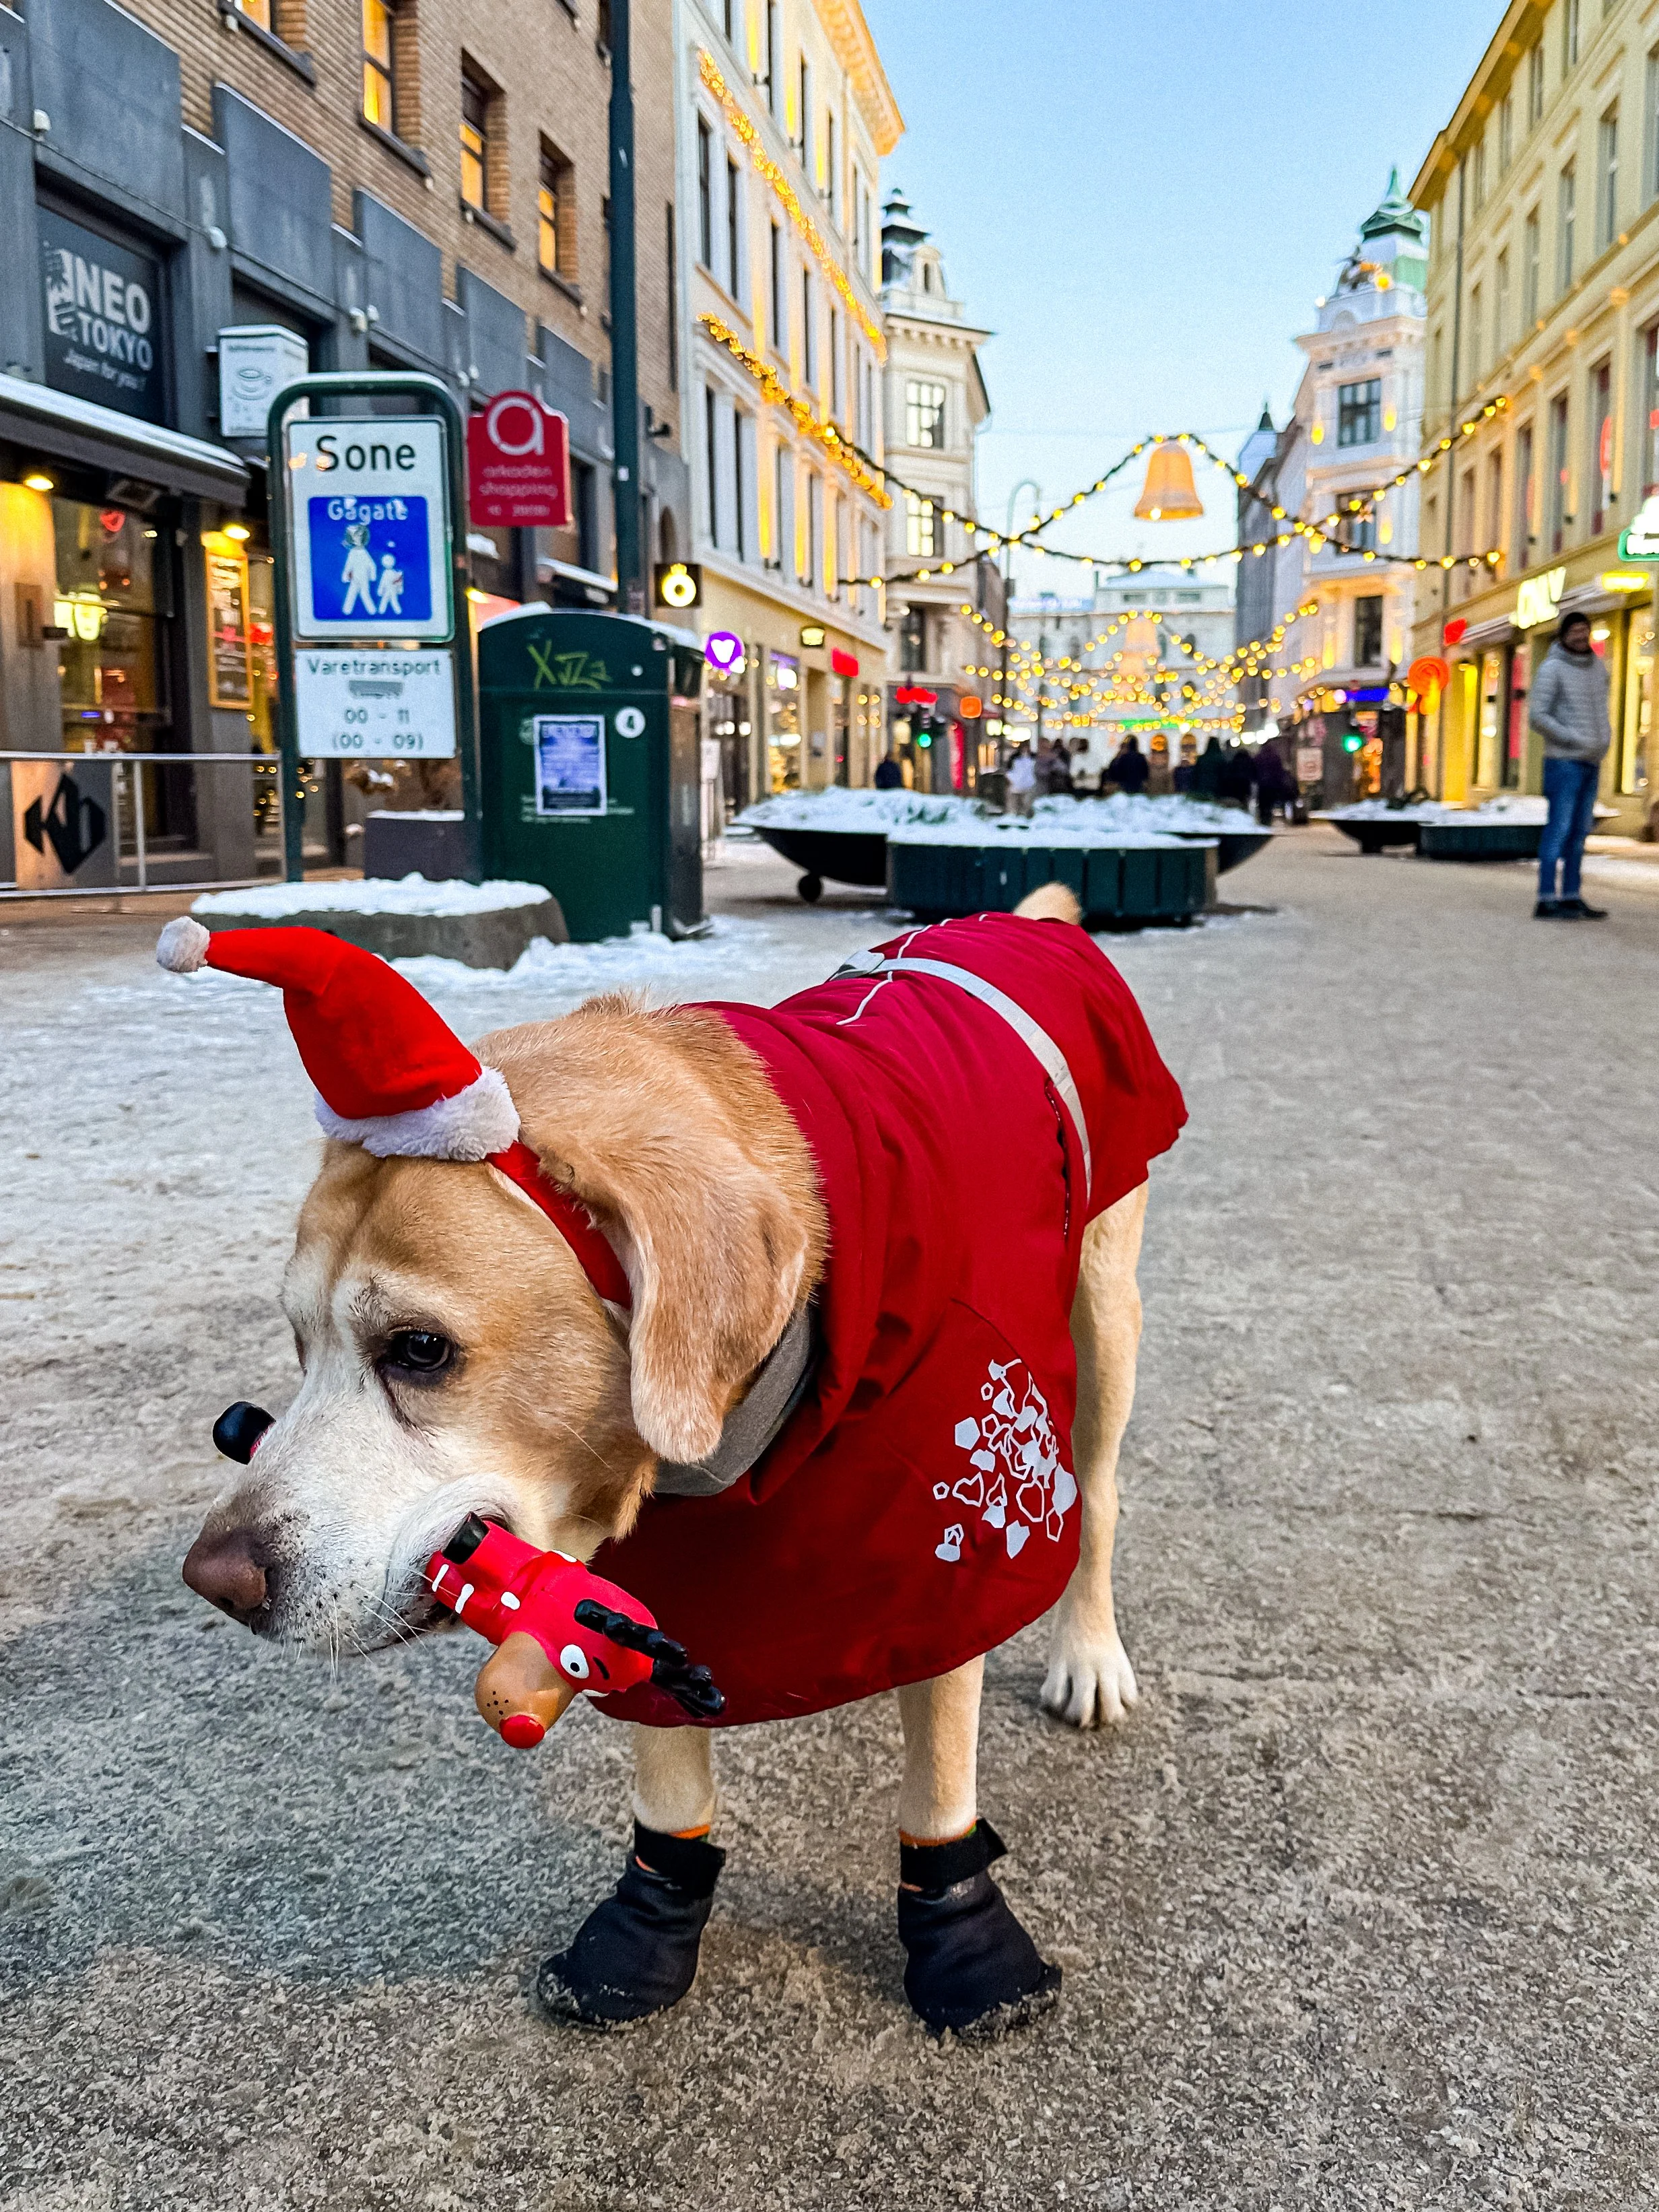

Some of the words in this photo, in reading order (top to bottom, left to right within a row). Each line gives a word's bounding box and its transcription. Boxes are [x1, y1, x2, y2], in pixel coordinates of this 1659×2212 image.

[75, 255, 151, 335] NEO
[77, 312, 154, 371] TOKYO
[316, 435, 416, 471] Sone
[308, 658, 441, 675] Varetransport
[344, 708, 369, 725] 00
[397, 708, 410, 724] 11
[332, 733, 364, 750] (00
[393, 733, 424, 750] 09)
